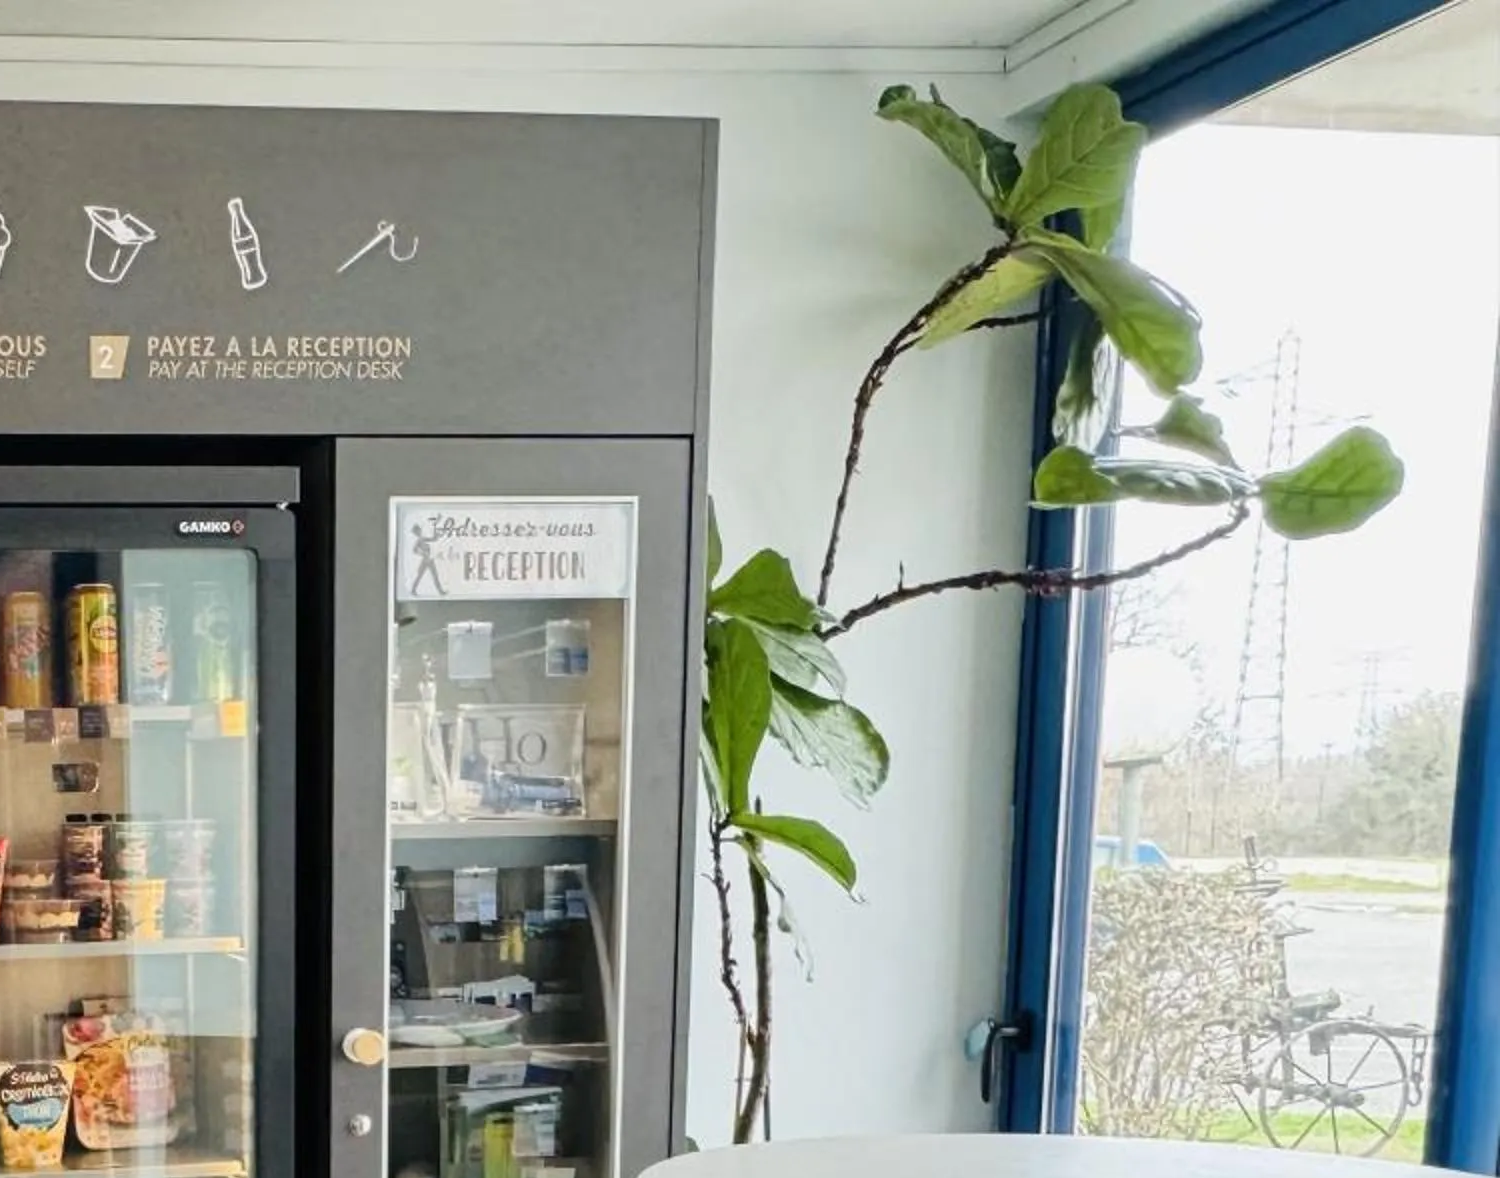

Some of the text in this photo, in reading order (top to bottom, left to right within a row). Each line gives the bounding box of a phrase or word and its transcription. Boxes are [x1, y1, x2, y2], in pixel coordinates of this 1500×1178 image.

[99, 345, 116, 370] 2
[147, 335, 412, 358] PAYEZ A LA RECEPTION
[149, 360, 404, 380] PAY AT THE RECEPTION DESK
[179, 521, 231, 533] GAMKO
[432, 516, 597, 539] Adressez-vous
[463, 551, 586, 582] RECEPTION
